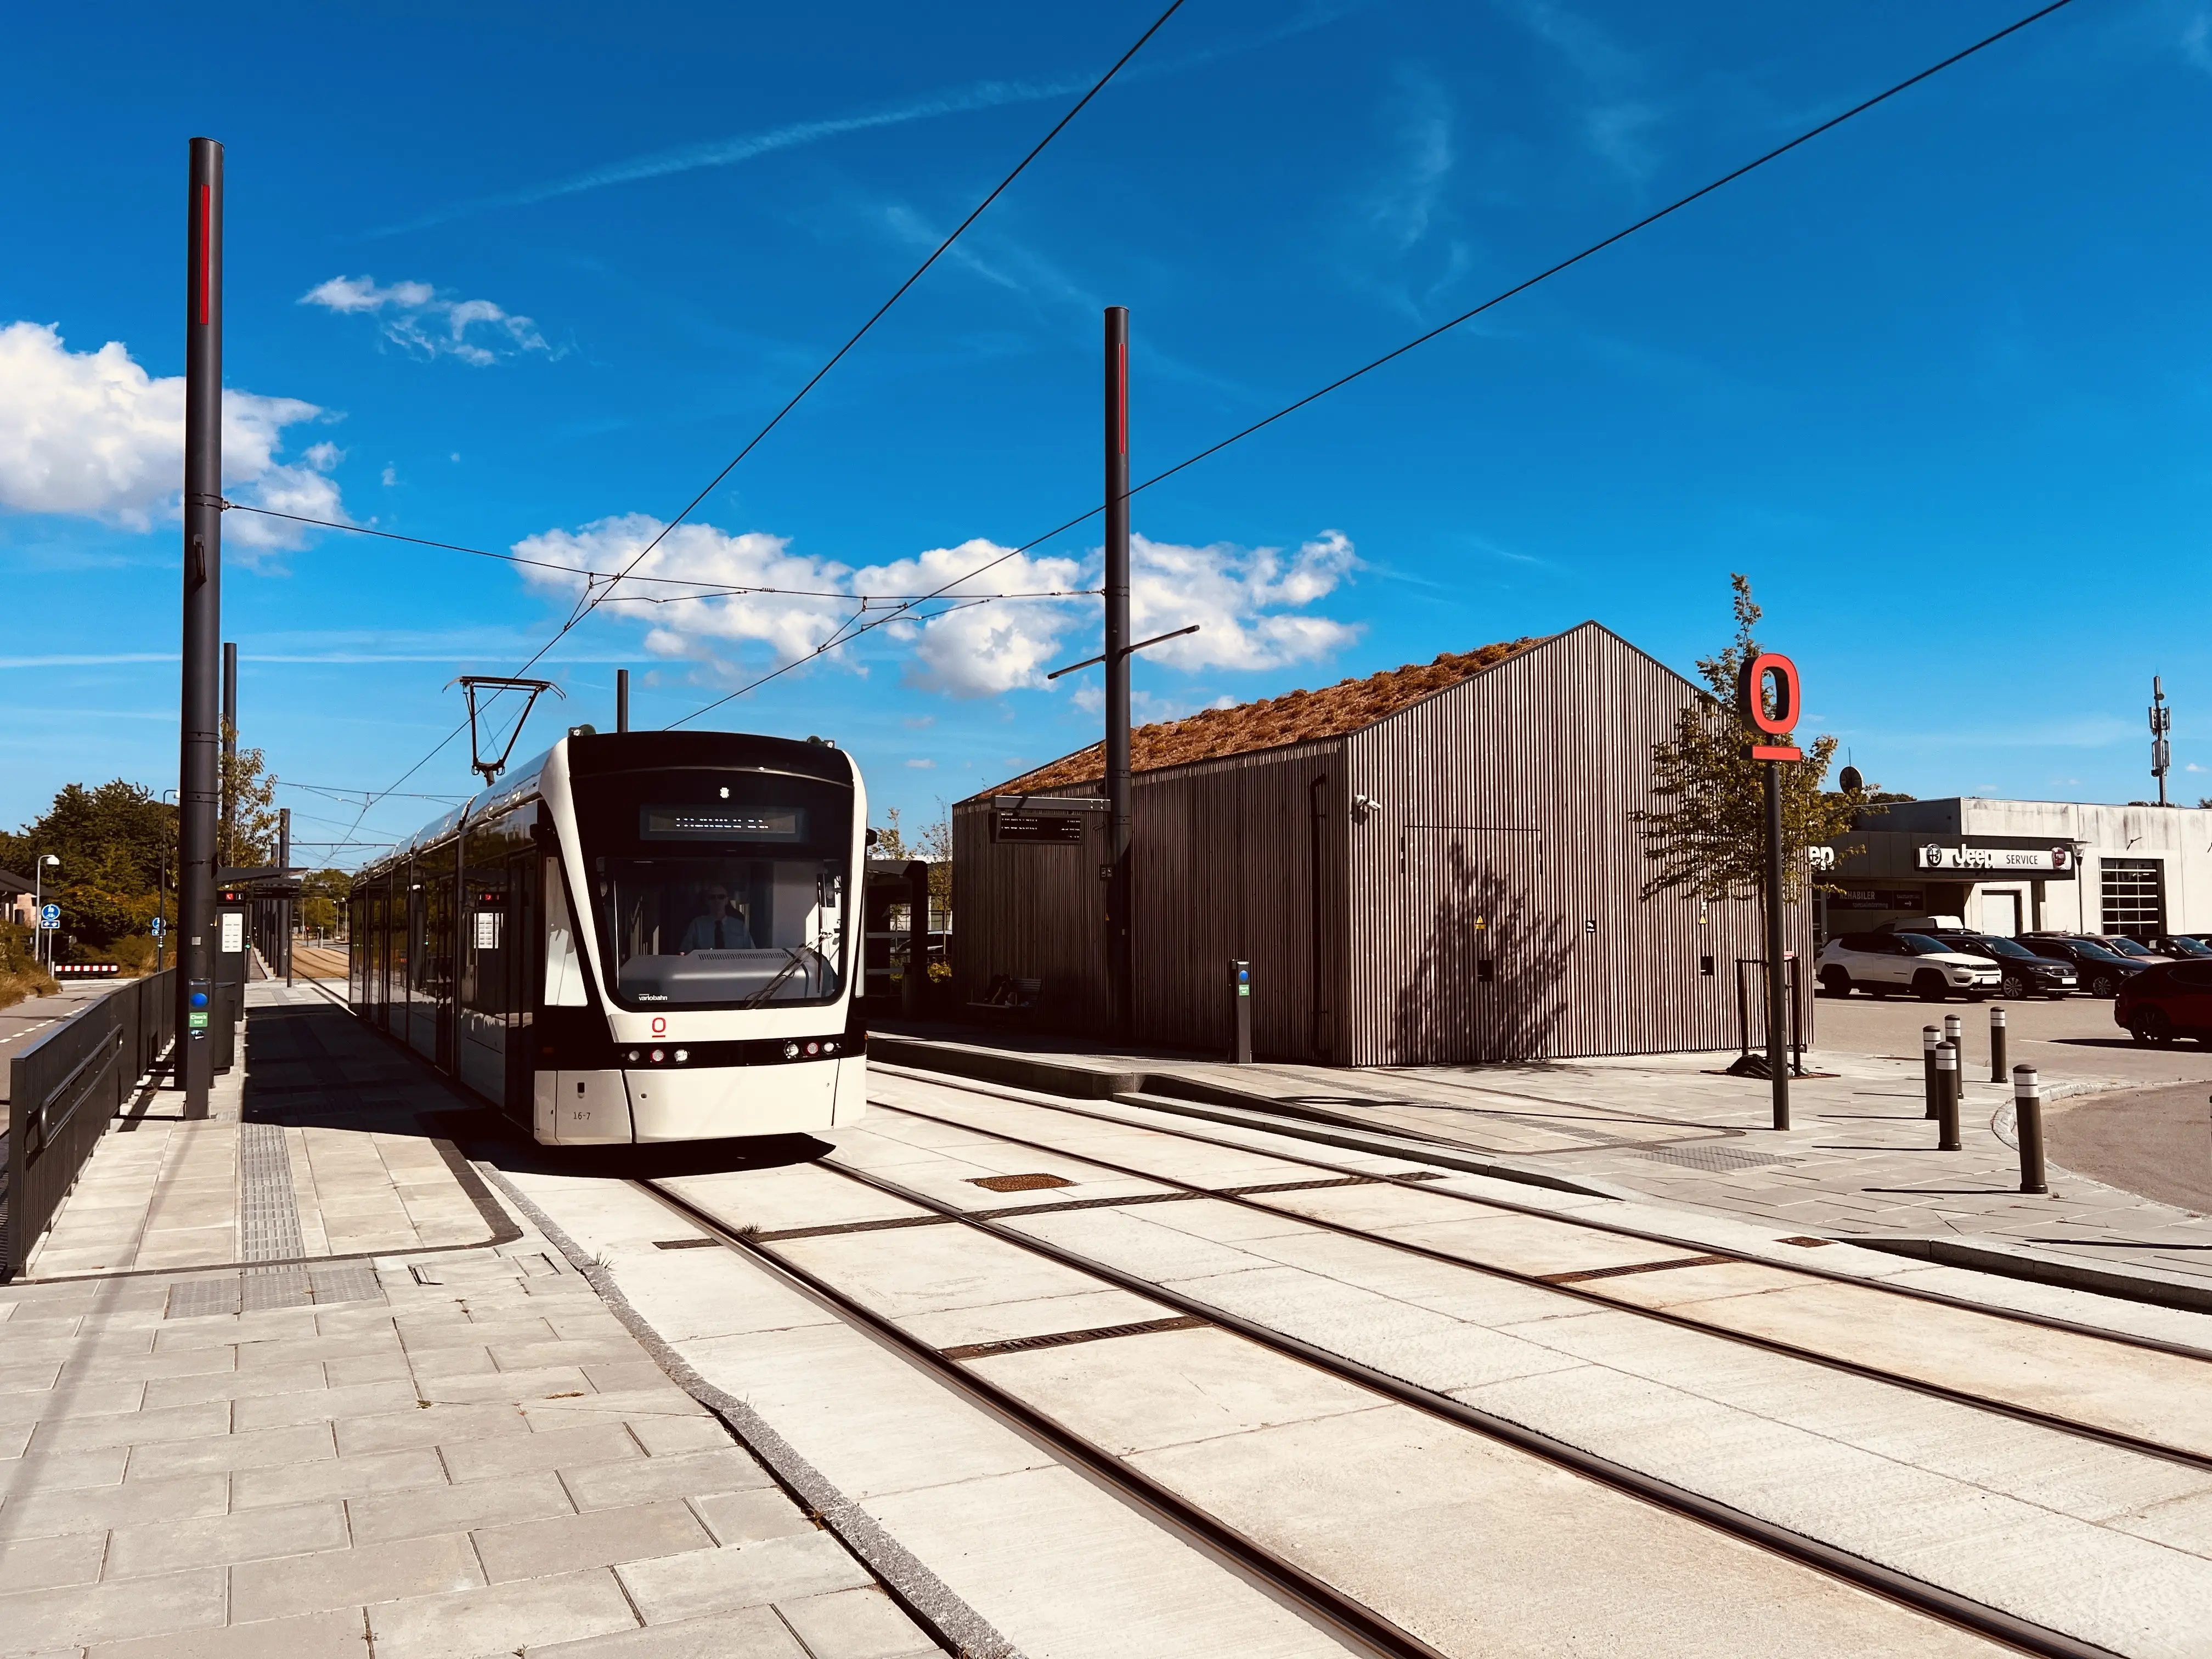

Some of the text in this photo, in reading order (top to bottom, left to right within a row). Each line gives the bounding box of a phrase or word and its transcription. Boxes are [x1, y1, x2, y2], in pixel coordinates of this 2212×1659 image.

[1953, 844, 1995, 868] Jeep
[2006, 855, 2038, 865] SERVICE
[573, 1111, 591, 1120] 16-7
